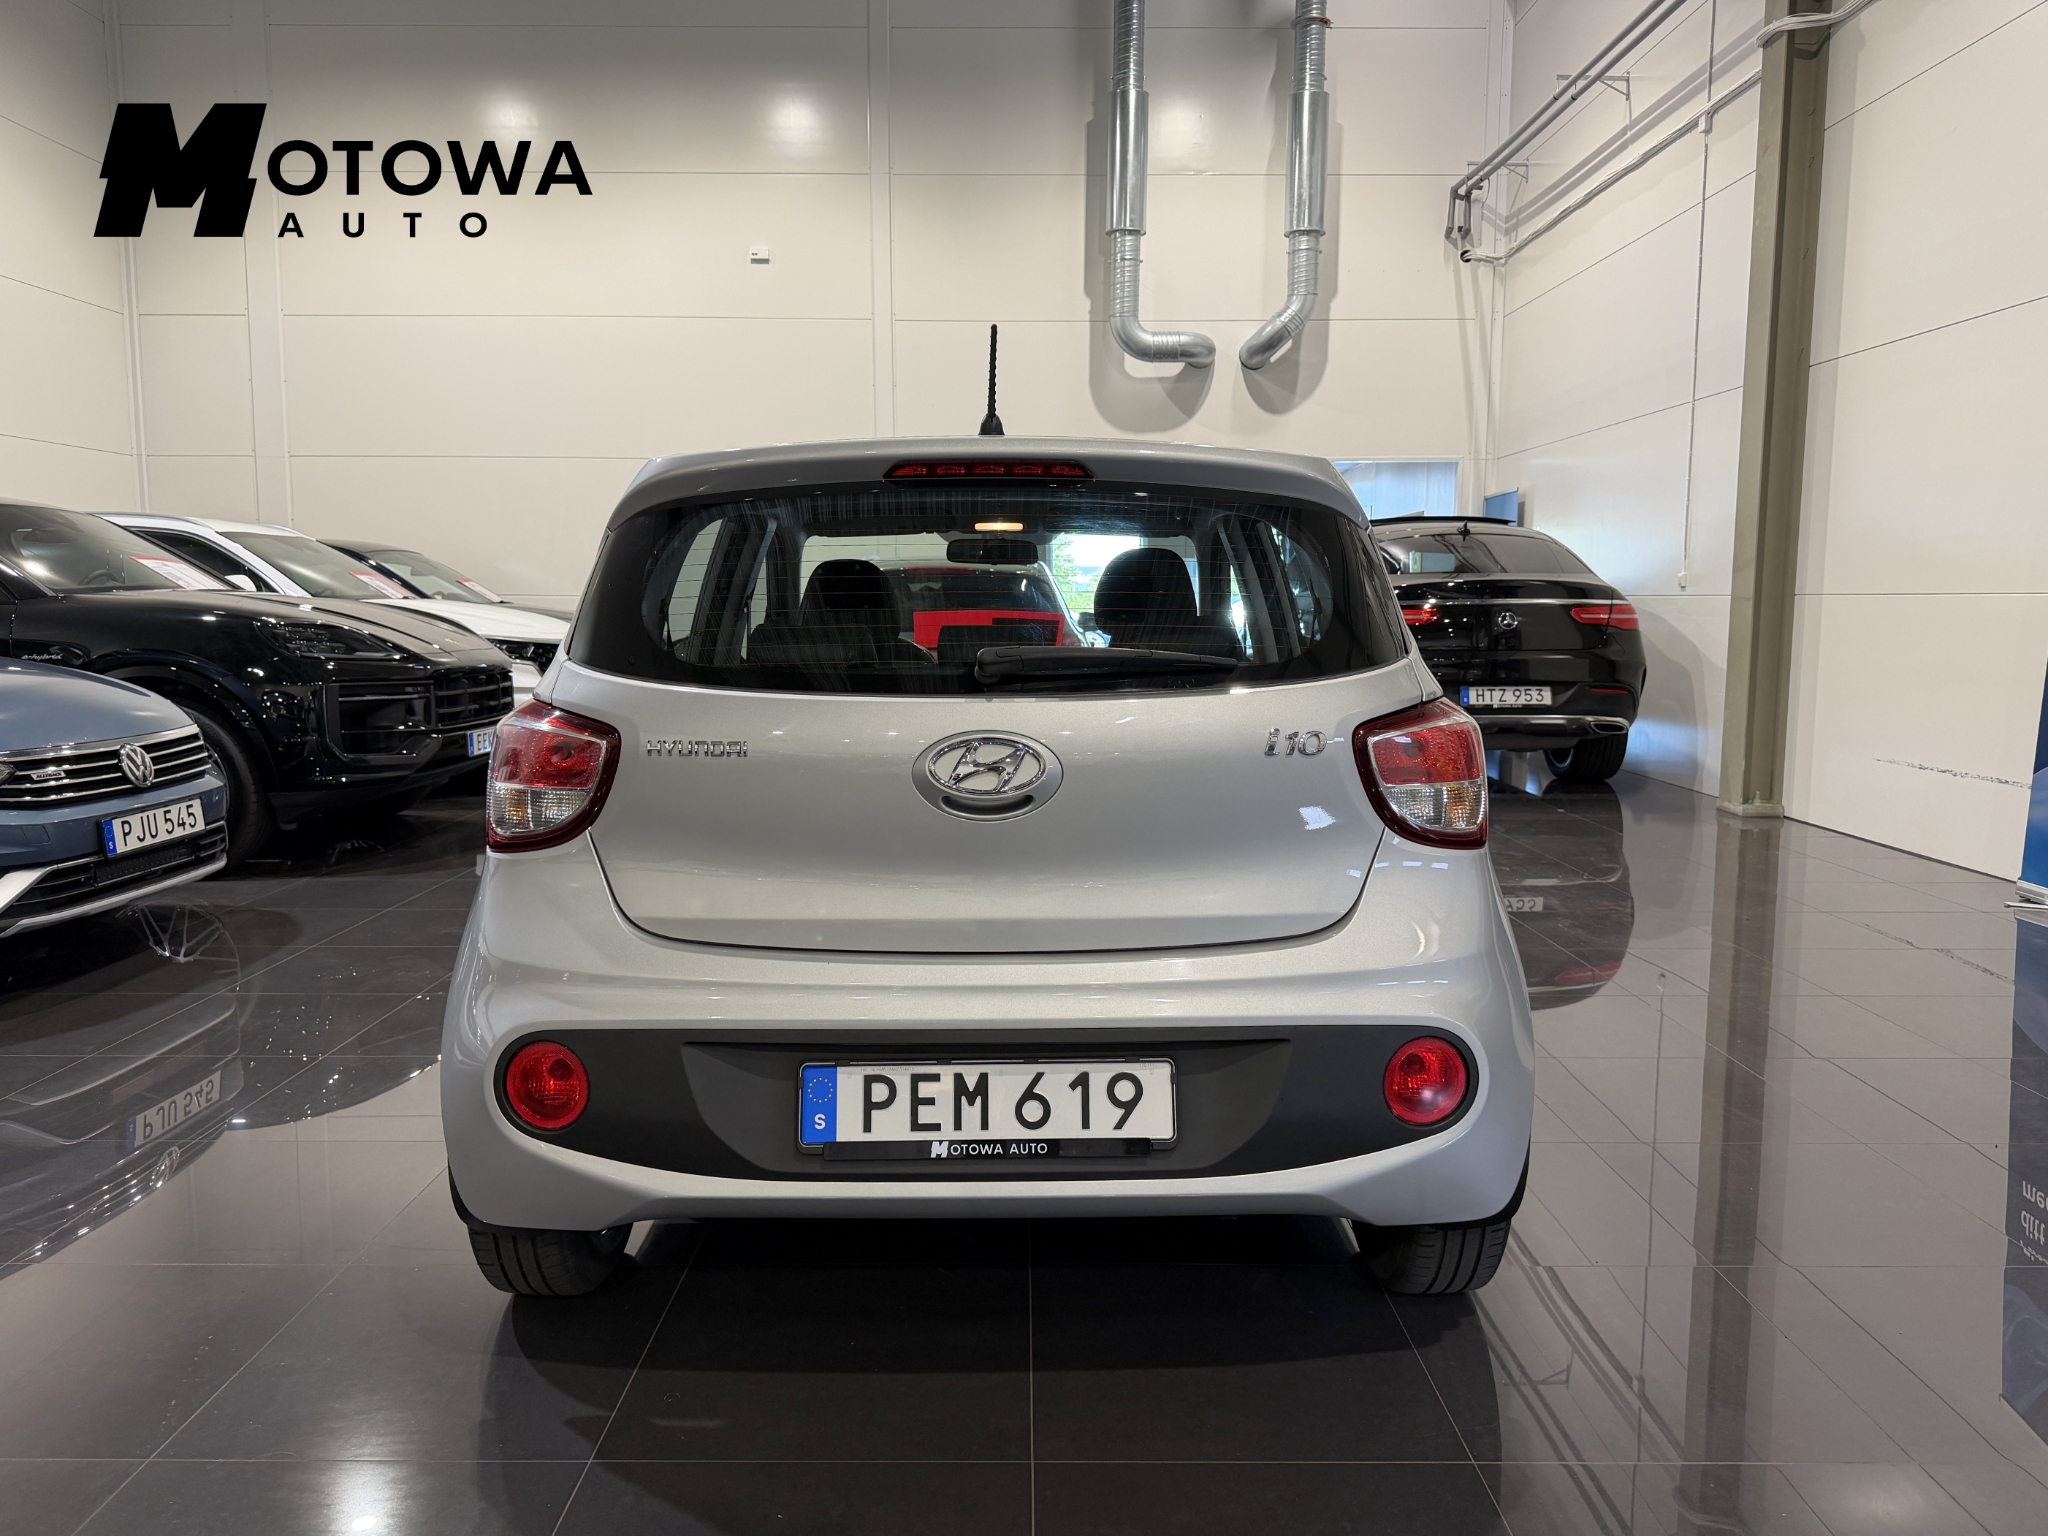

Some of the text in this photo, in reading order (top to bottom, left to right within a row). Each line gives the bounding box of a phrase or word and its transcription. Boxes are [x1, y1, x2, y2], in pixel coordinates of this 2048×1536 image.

[1475, 688, 1544, 703] HTZ 953
[647, 740, 748, 757] HYUNDAI
[1264, 727, 1327, 756] i10
[121, 804, 197, 847] PJU 545
[862, 1071, 1145, 1133] PEM 619
[814, 1114, 826, 1130] S
[930, 1141, 1048, 1158] MOTOWA AUTO
